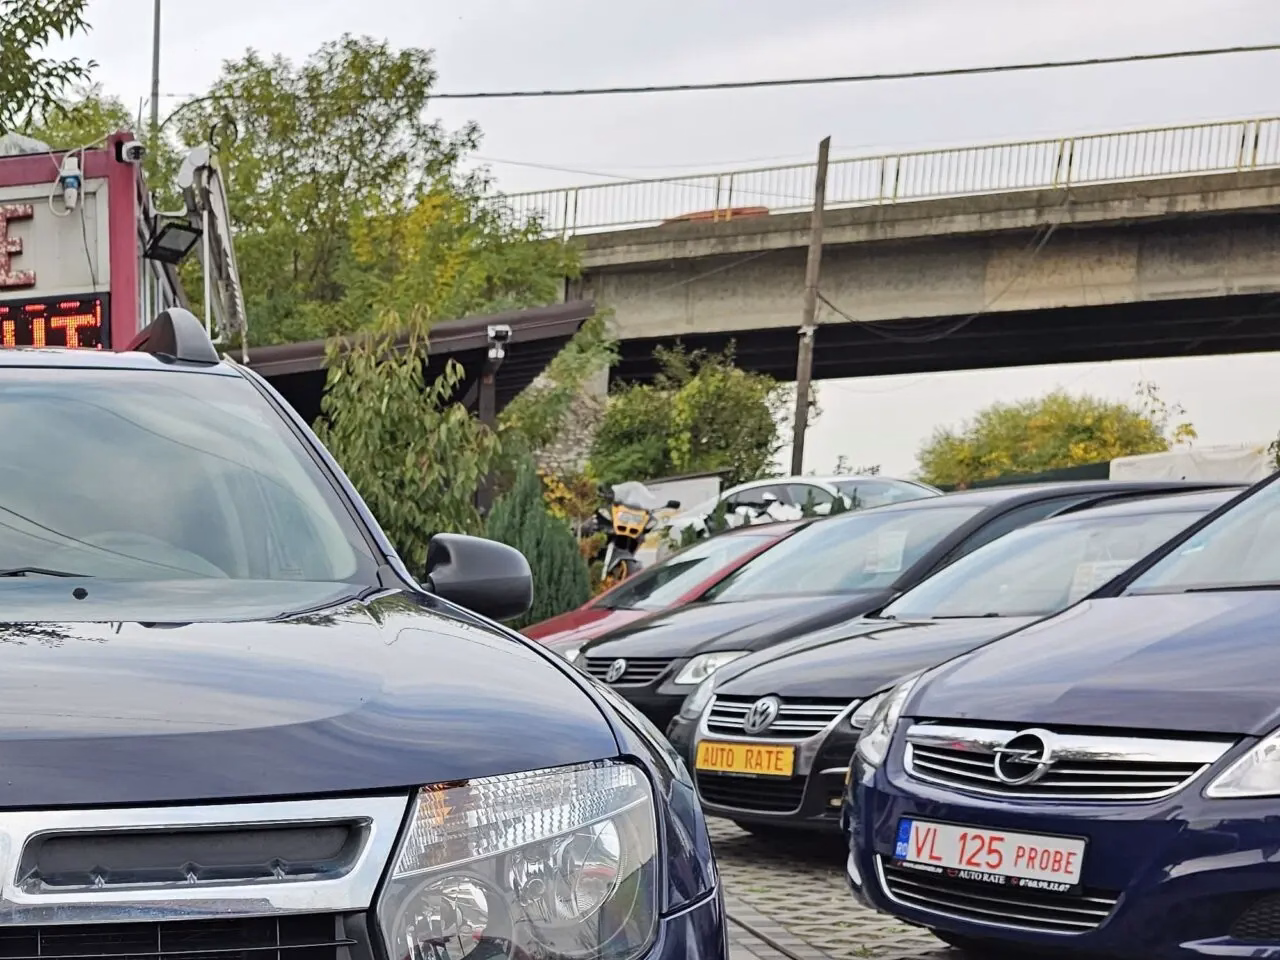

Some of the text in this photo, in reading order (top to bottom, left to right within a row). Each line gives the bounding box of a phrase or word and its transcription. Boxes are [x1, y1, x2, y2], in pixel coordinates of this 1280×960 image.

[702, 746, 785, 772] AUTO RATE
[914, 826, 1078, 875] VL 125 PROBE
[958, 870, 1006, 885] AUTO RATE
